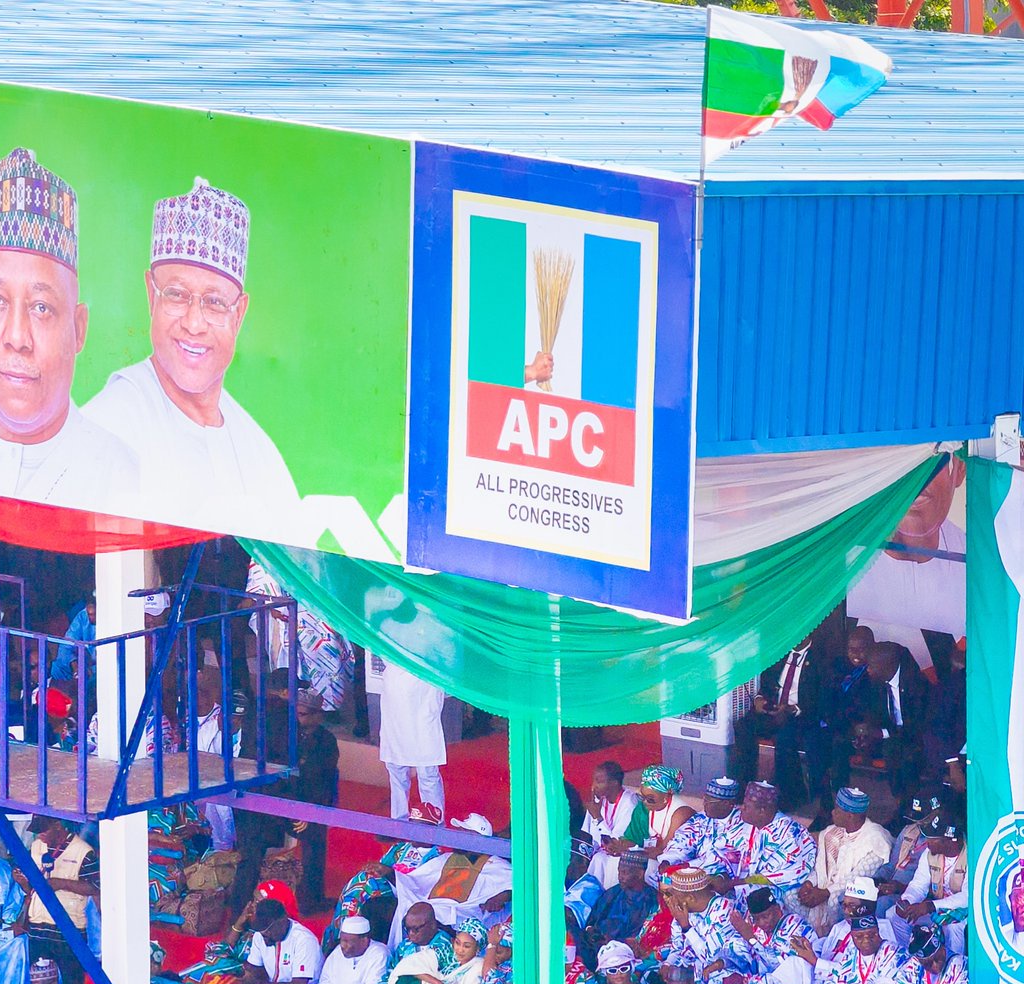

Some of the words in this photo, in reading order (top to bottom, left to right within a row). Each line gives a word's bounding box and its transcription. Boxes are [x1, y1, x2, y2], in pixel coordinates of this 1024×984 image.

[497, 398, 604, 468] APC
[476, 472, 504, 493] ALL
[509, 478, 623, 515] PROGRESSIVES
[508, 503, 590, 534] CONGRESS
